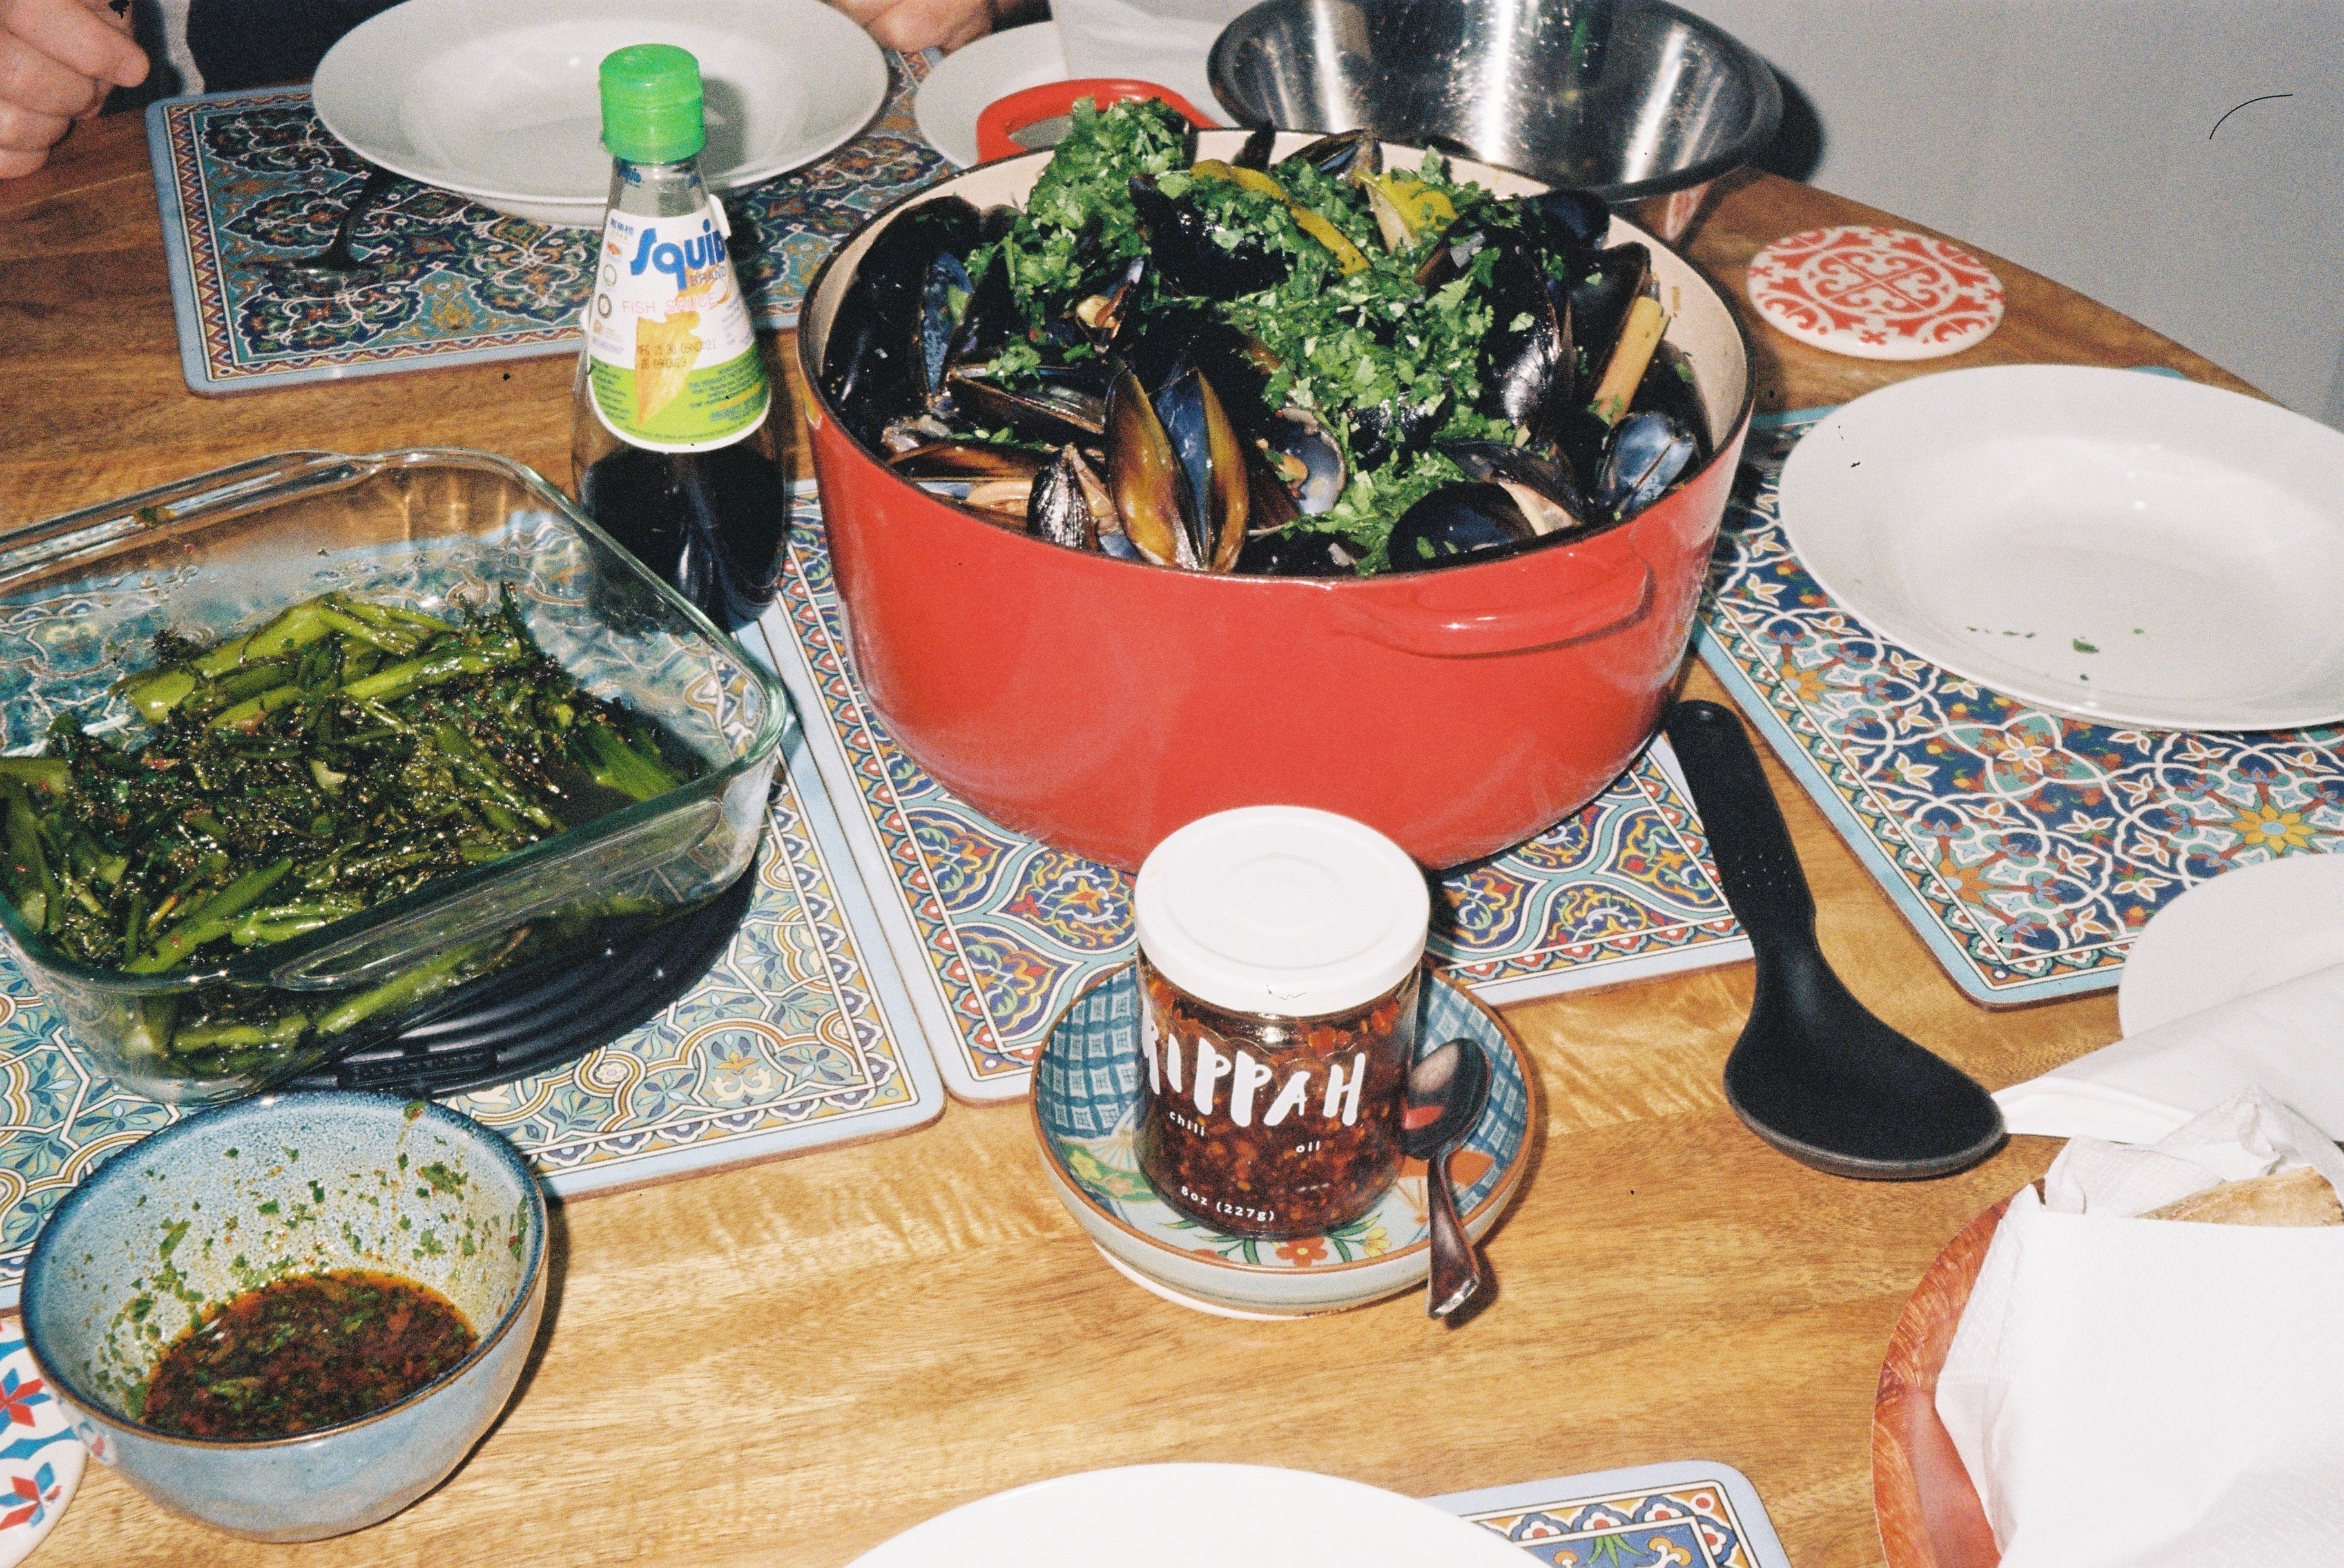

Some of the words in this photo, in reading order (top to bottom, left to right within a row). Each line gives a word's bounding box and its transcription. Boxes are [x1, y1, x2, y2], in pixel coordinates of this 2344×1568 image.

[689, 266, 726, 286] BRAND
[622, 300, 656, 315] FISH
[666, 292, 715, 313] SAUCE
[1170, 1111, 1205, 1136] chili
[1295, 1140, 1320, 1153] oil
[1181, 1185, 1208, 1206] 8oz
[1216, 1201, 1274, 1222] (227g)
